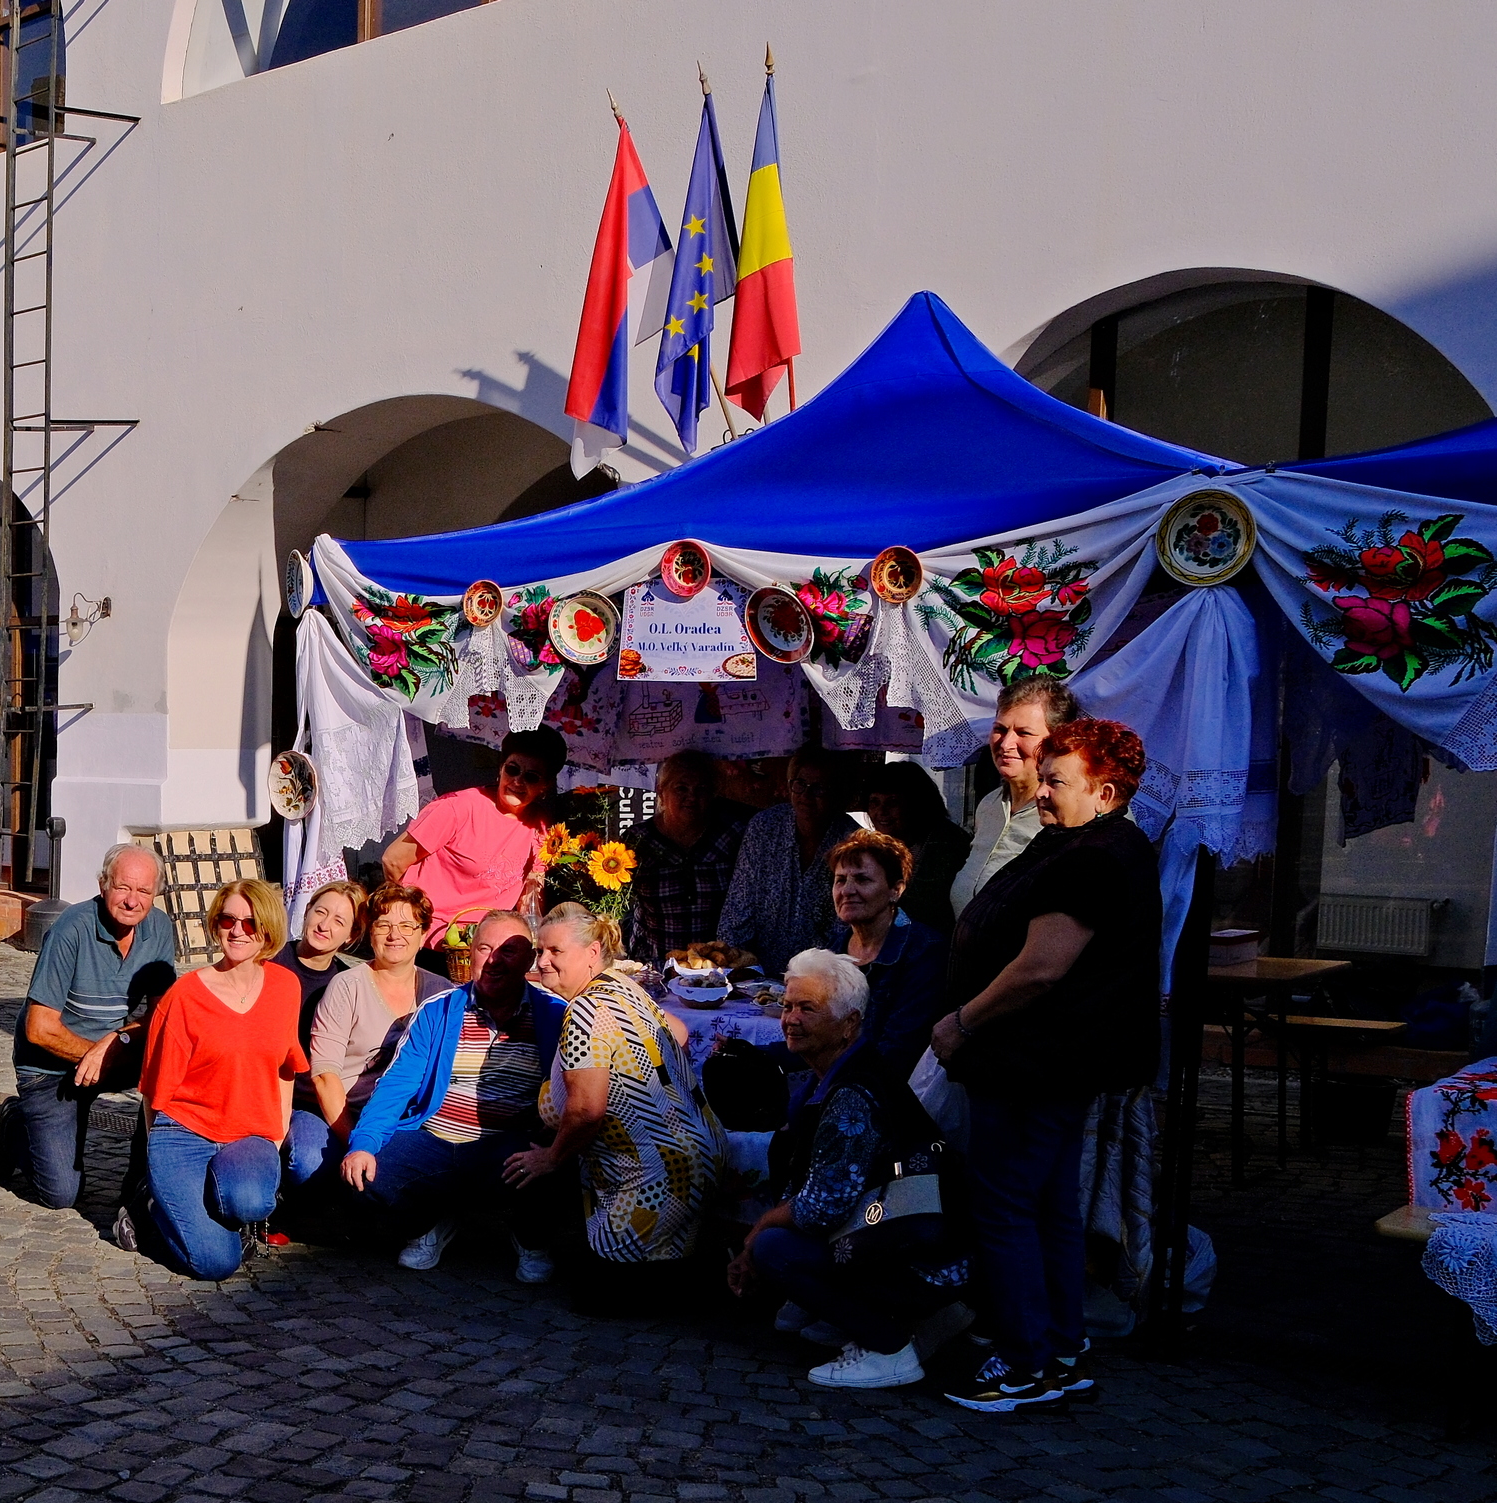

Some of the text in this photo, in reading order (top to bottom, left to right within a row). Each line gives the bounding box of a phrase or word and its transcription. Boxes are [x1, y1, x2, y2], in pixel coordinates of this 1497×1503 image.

[649, 622, 721, 635] O.L. Oradea
[638, 642, 658, 652] M.O.
[691, 641, 735, 652] Varadín
[867, 1206, 880, 1222] M
